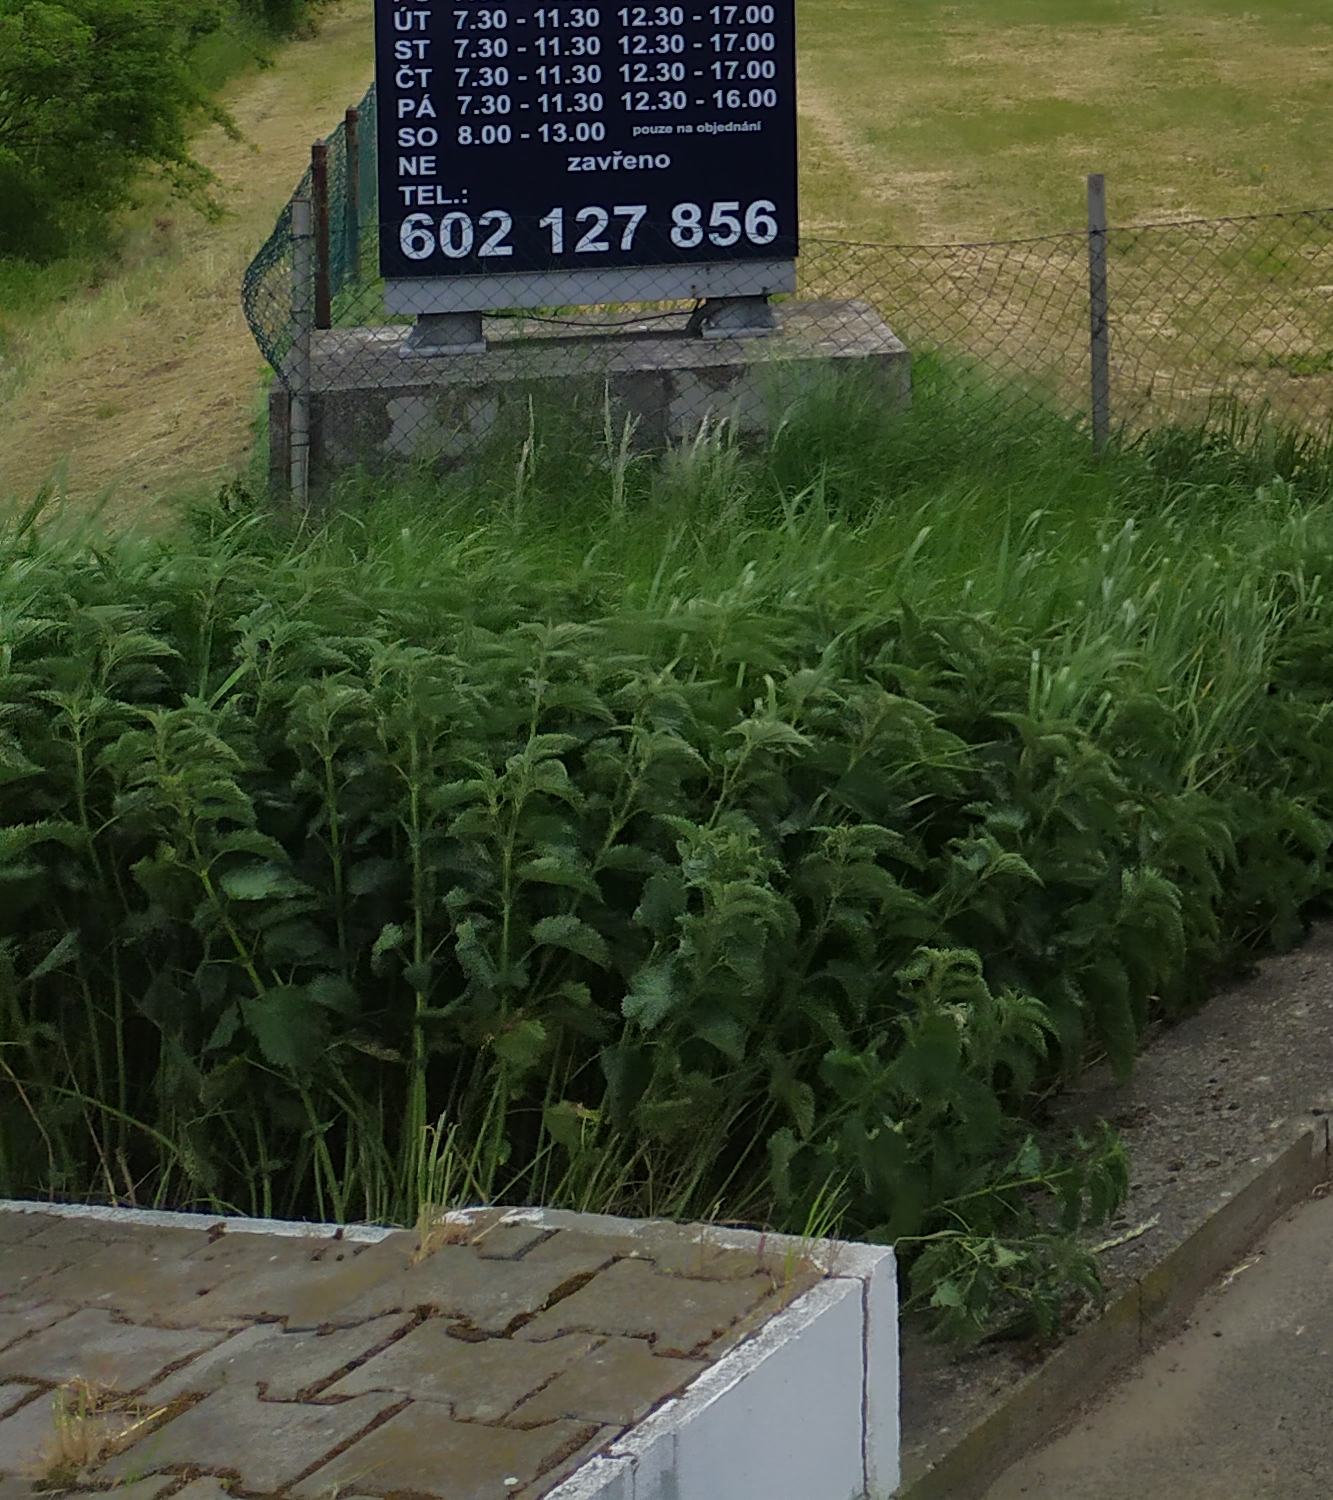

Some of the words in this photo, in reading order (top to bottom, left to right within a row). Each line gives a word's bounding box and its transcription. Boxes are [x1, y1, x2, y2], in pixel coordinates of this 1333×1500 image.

[394, 6, 432, 31] ÚT
[453, 9, 508, 30] 7.30
[533, 8, 600, 28] 11.30
[617, 6, 684, 27] 12.30
[709, 4, 774, 25] 17.00
[394, 39, 431, 60] ST
[454, 38, 508, 59] 7.30
[534, 36, 601, 56] 11.30
[618, 34, 685, 55] 12.30
[710, 32, 775, 52] 17.00
[395, 64, 433, 89] ČT
[454, 66, 509, 87] 7.30
[535, 64, 602, 85] 11.30
[619, 62, 685, 83] 12.30
[710, 60, 776, 80] 17.00
[398, 93, 437, 119] PÁ
[457, 94, 511, 115] 7.30
[537, 92, 603, 113] 11.30
[620, 90, 687, 111] 12.30
[712, 88, 777, 109] 16.00
[397, 126, 438, 148] SO
[457, 124, 512, 145] 8.00
[537, 121, 605, 143] 13.00
[632, 125, 673, 137] pouze
[676, 124, 693, 134] na
[696, 120, 761, 135] objednání
[398, 155, 437, 176] NE
[567, 150, 671, 172] zavřeno
[398, 185, 468, 206] TEL.:
[399, 209, 513, 260] 602
[539, 204, 647, 254] 127
[670, 199, 778, 248] 856
